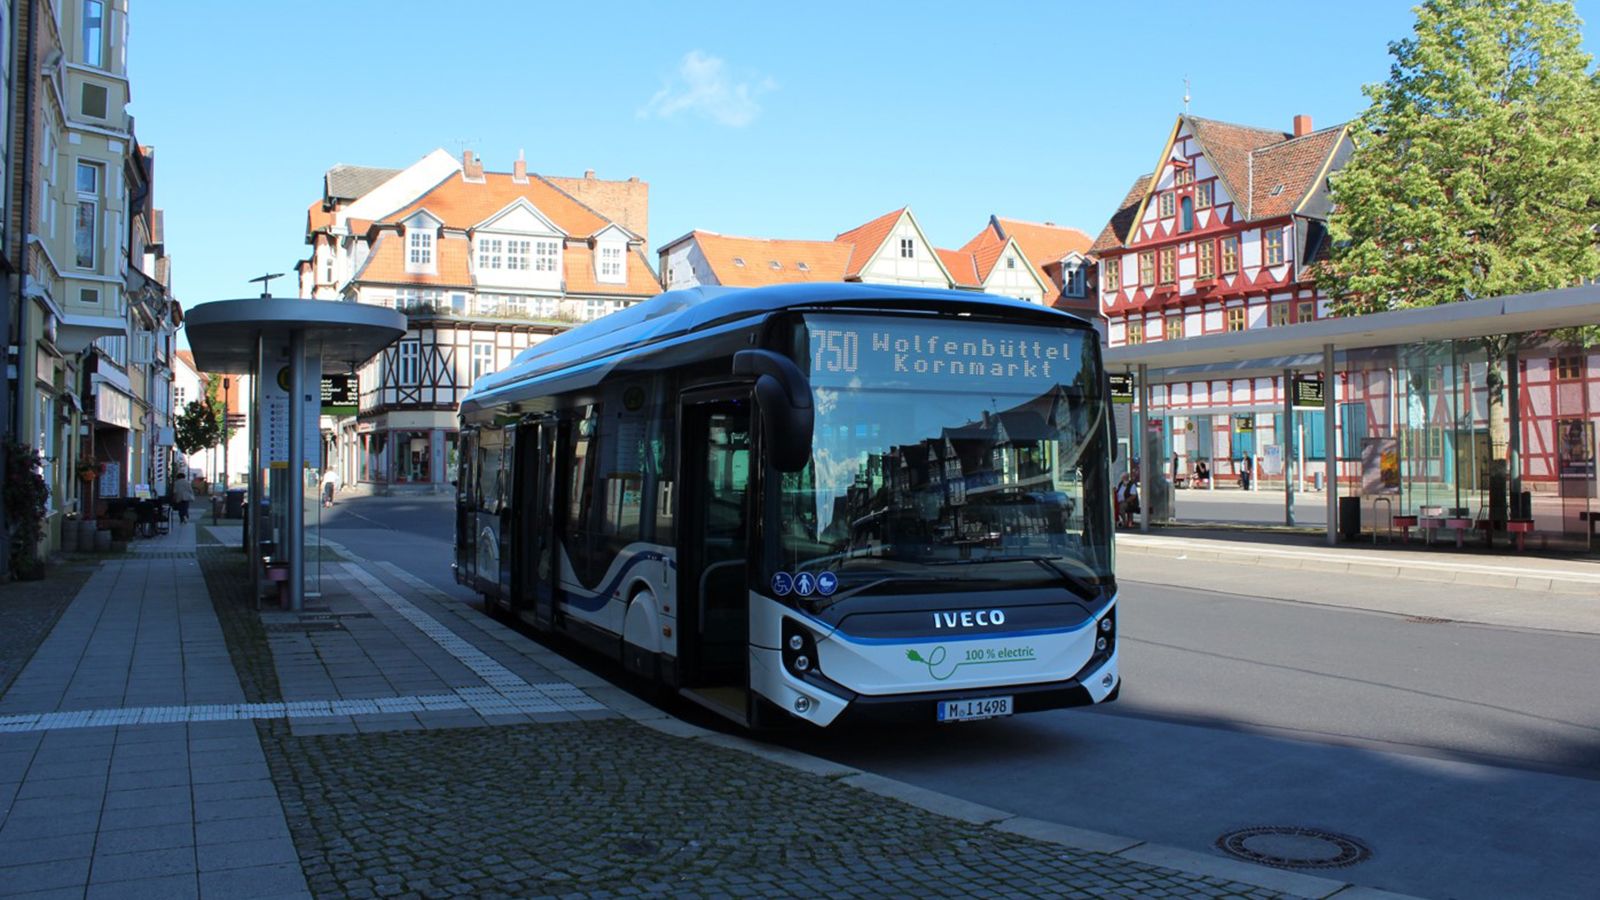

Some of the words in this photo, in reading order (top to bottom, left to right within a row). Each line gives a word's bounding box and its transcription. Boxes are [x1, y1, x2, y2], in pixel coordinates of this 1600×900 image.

[811, 329, 858, 372] 750
[872, 332, 1070, 360] Wolfenbüttel
[894, 353, 1052, 378] Kornmarkt
[934, 610, 1005, 628] IVECO
[966, 650, 984, 660] 100
[987, 649, 996, 660] %
[998, 646, 1034, 658] electric
[949, 704, 958, 717] M
[976, 699, 1007, 715] 1498
